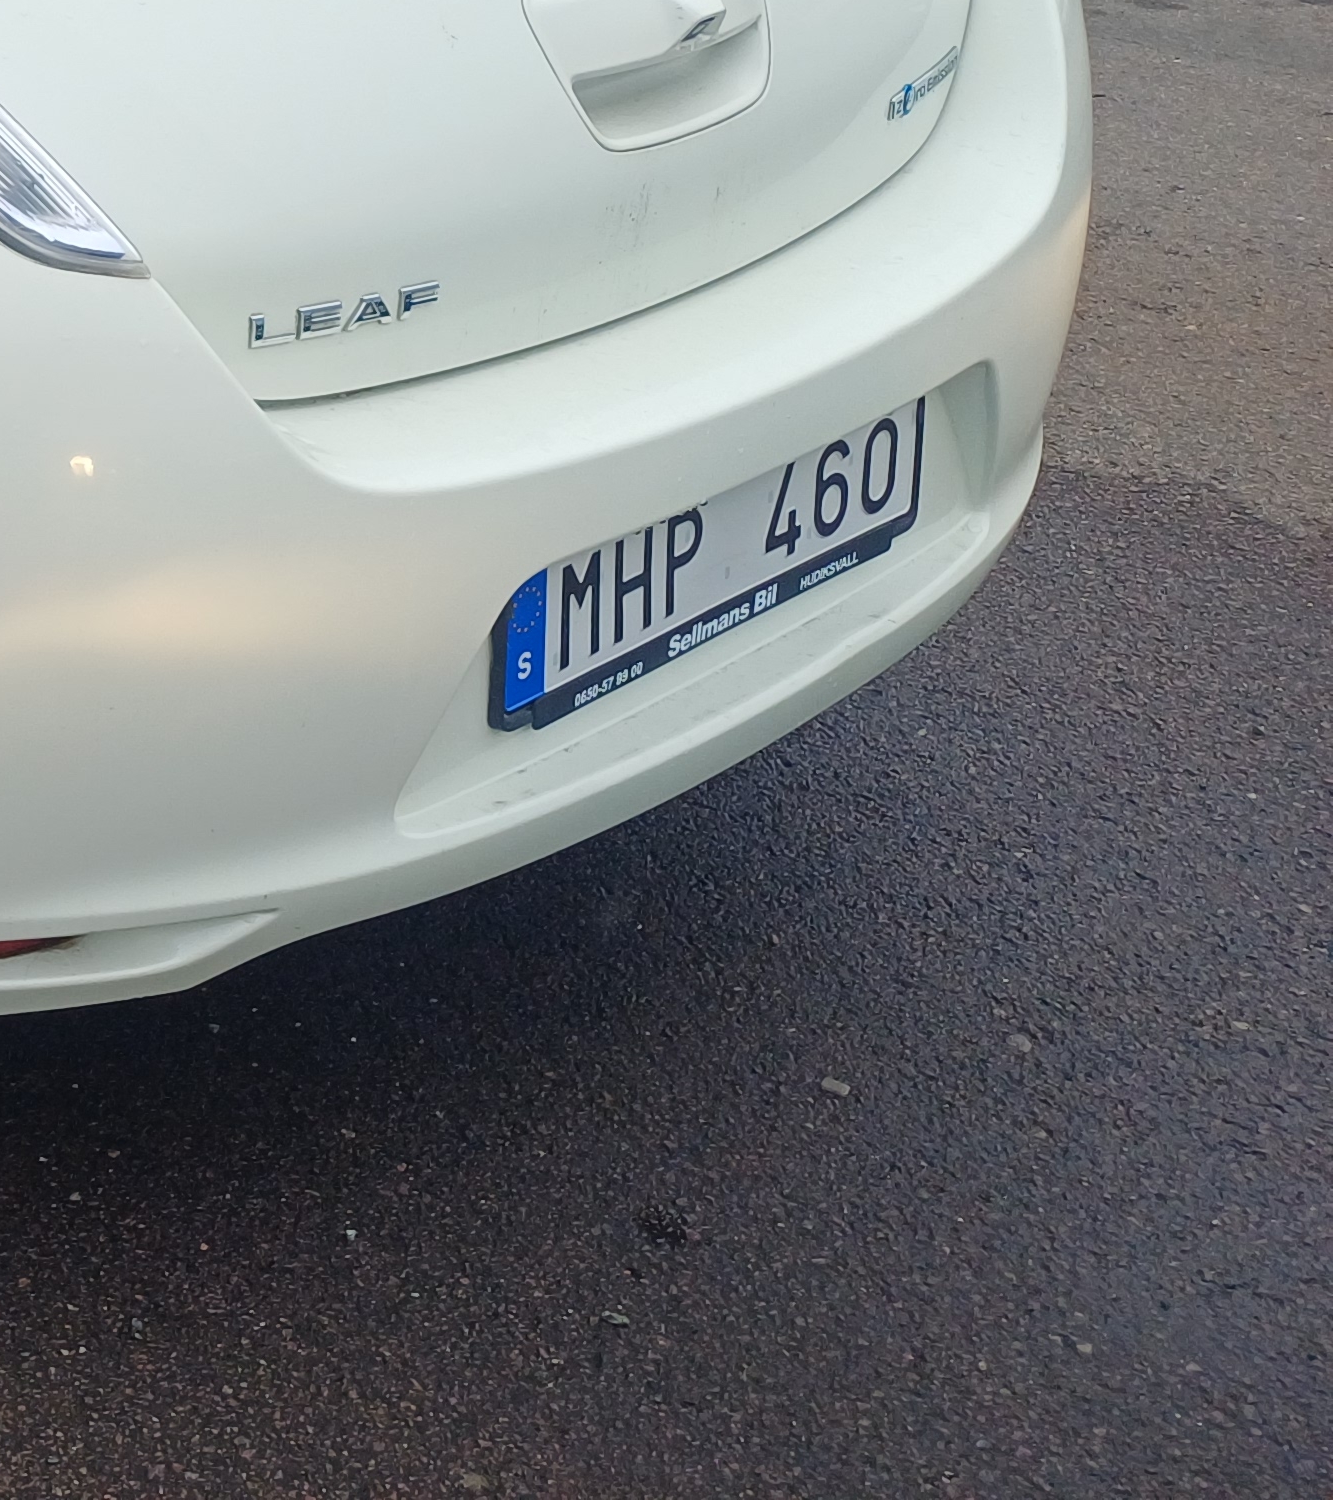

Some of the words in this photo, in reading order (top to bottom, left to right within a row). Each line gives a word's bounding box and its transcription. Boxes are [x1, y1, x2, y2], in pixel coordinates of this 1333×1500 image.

[248, 280, 441, 349] LEAF
[559, 509, 703, 672] MHP
[765, 418, 899, 558] 460
[799, 551, 859, 590] HUDIKSVALL
[667, 602, 750, 658] Sellmans
[753, 583, 778, 614] Bil
[517, 652, 532, 680] S
[631, 661, 644, 678] 00
